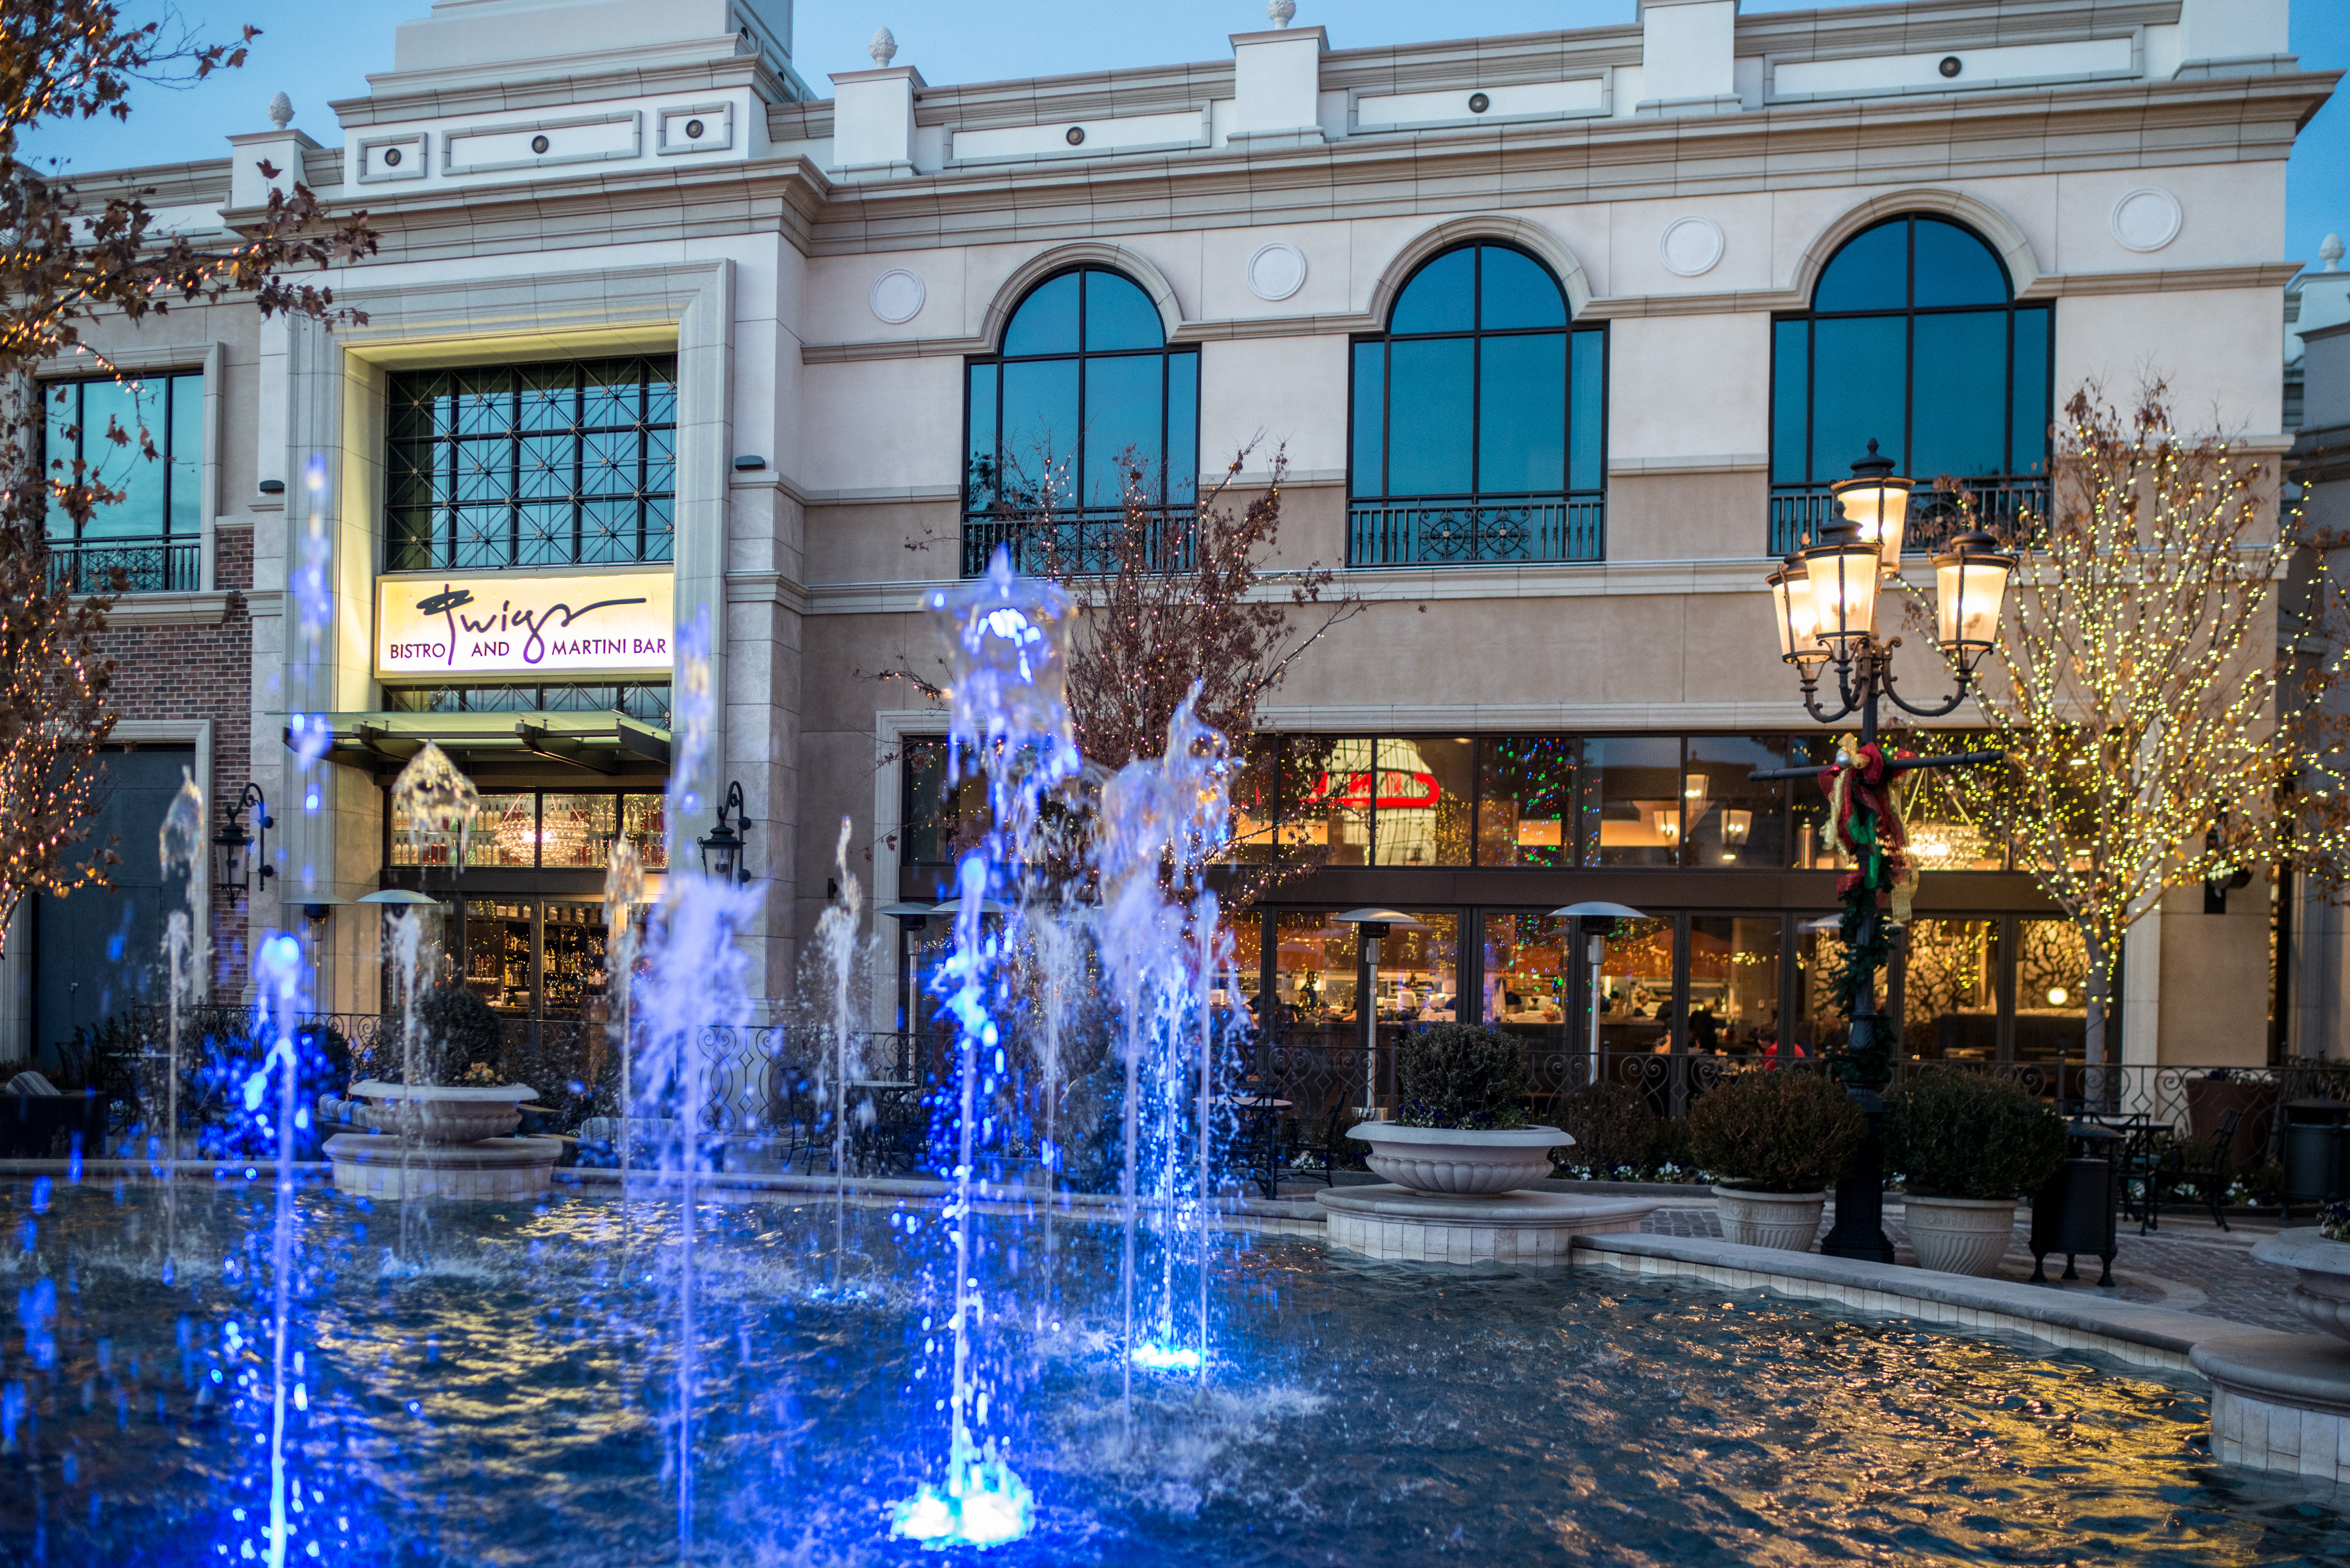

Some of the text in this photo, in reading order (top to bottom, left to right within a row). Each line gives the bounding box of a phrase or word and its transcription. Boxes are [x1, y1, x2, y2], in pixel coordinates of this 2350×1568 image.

[390, 638, 666, 658] BISTRO AND MARTINI BAR
[416, 583, 647, 665] Twigs
